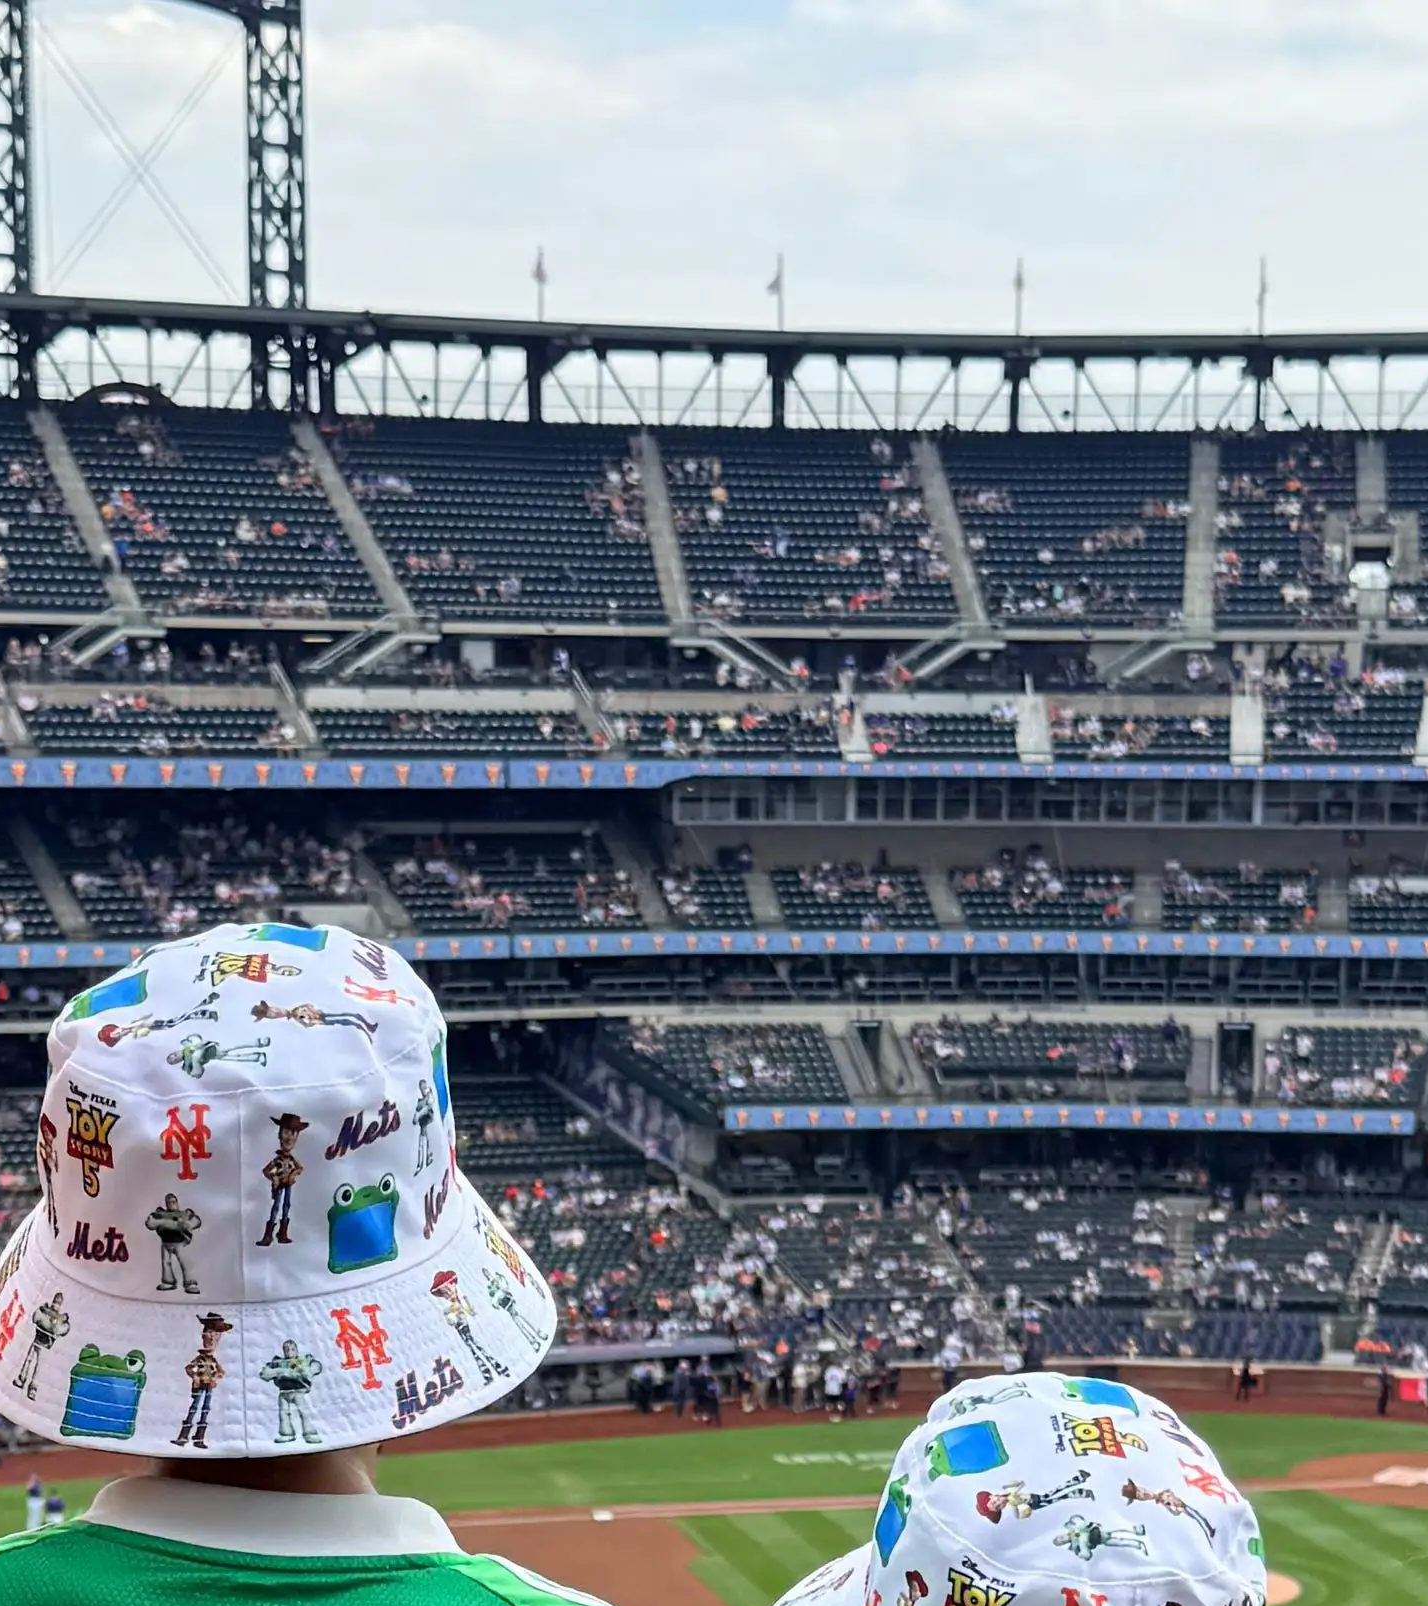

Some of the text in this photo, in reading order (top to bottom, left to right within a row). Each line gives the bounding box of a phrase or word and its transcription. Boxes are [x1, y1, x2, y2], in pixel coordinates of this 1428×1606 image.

[66, 1097, 121, 1146] TOY
[325, 1100, 401, 1161] Mets
[70, 1139, 110, 1162] STORY
[82, 1158, 100, 1198] 5
[67, 1221, 130, 1263] Mets
[392, 1355, 464, 1430] Mets
[1061, 1412, 1104, 1457] TOY
